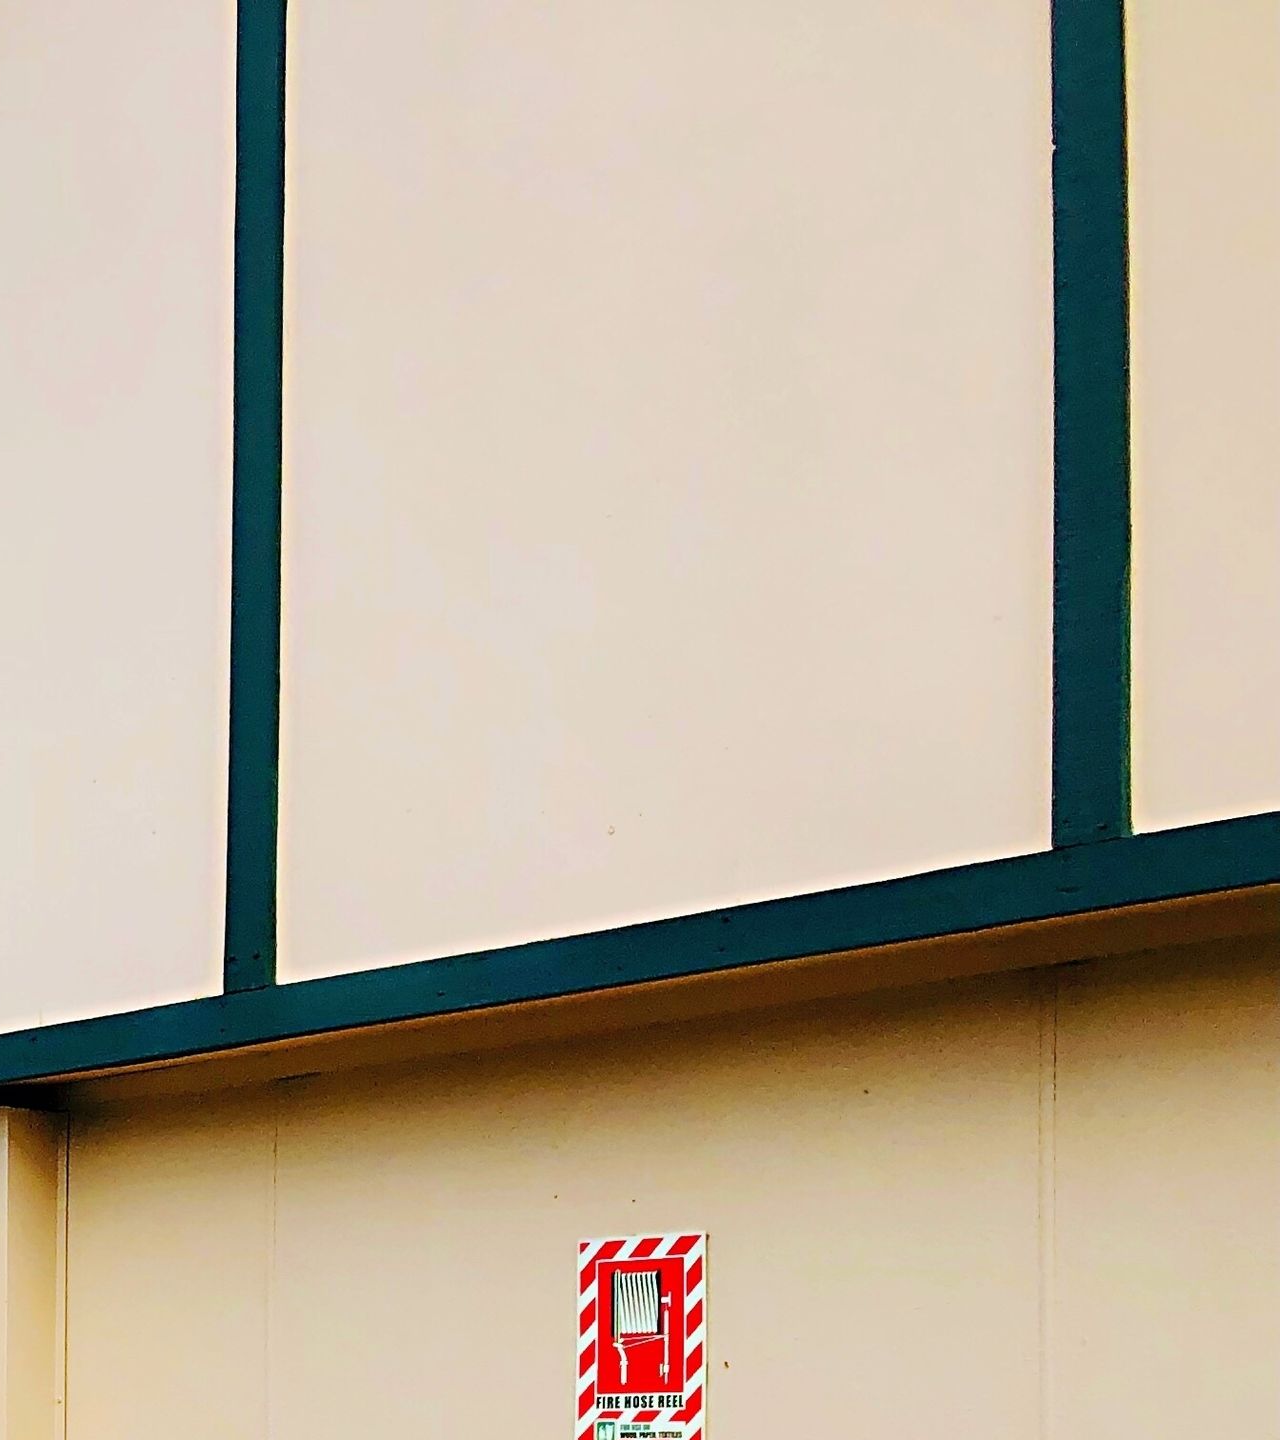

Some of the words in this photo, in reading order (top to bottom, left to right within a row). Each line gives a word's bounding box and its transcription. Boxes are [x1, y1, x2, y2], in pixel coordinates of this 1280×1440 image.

[596, 1396, 620, 1409] FIRE
[624, 1396, 654, 1408] HOSE
[658, 1395, 684, 1408] REEL
